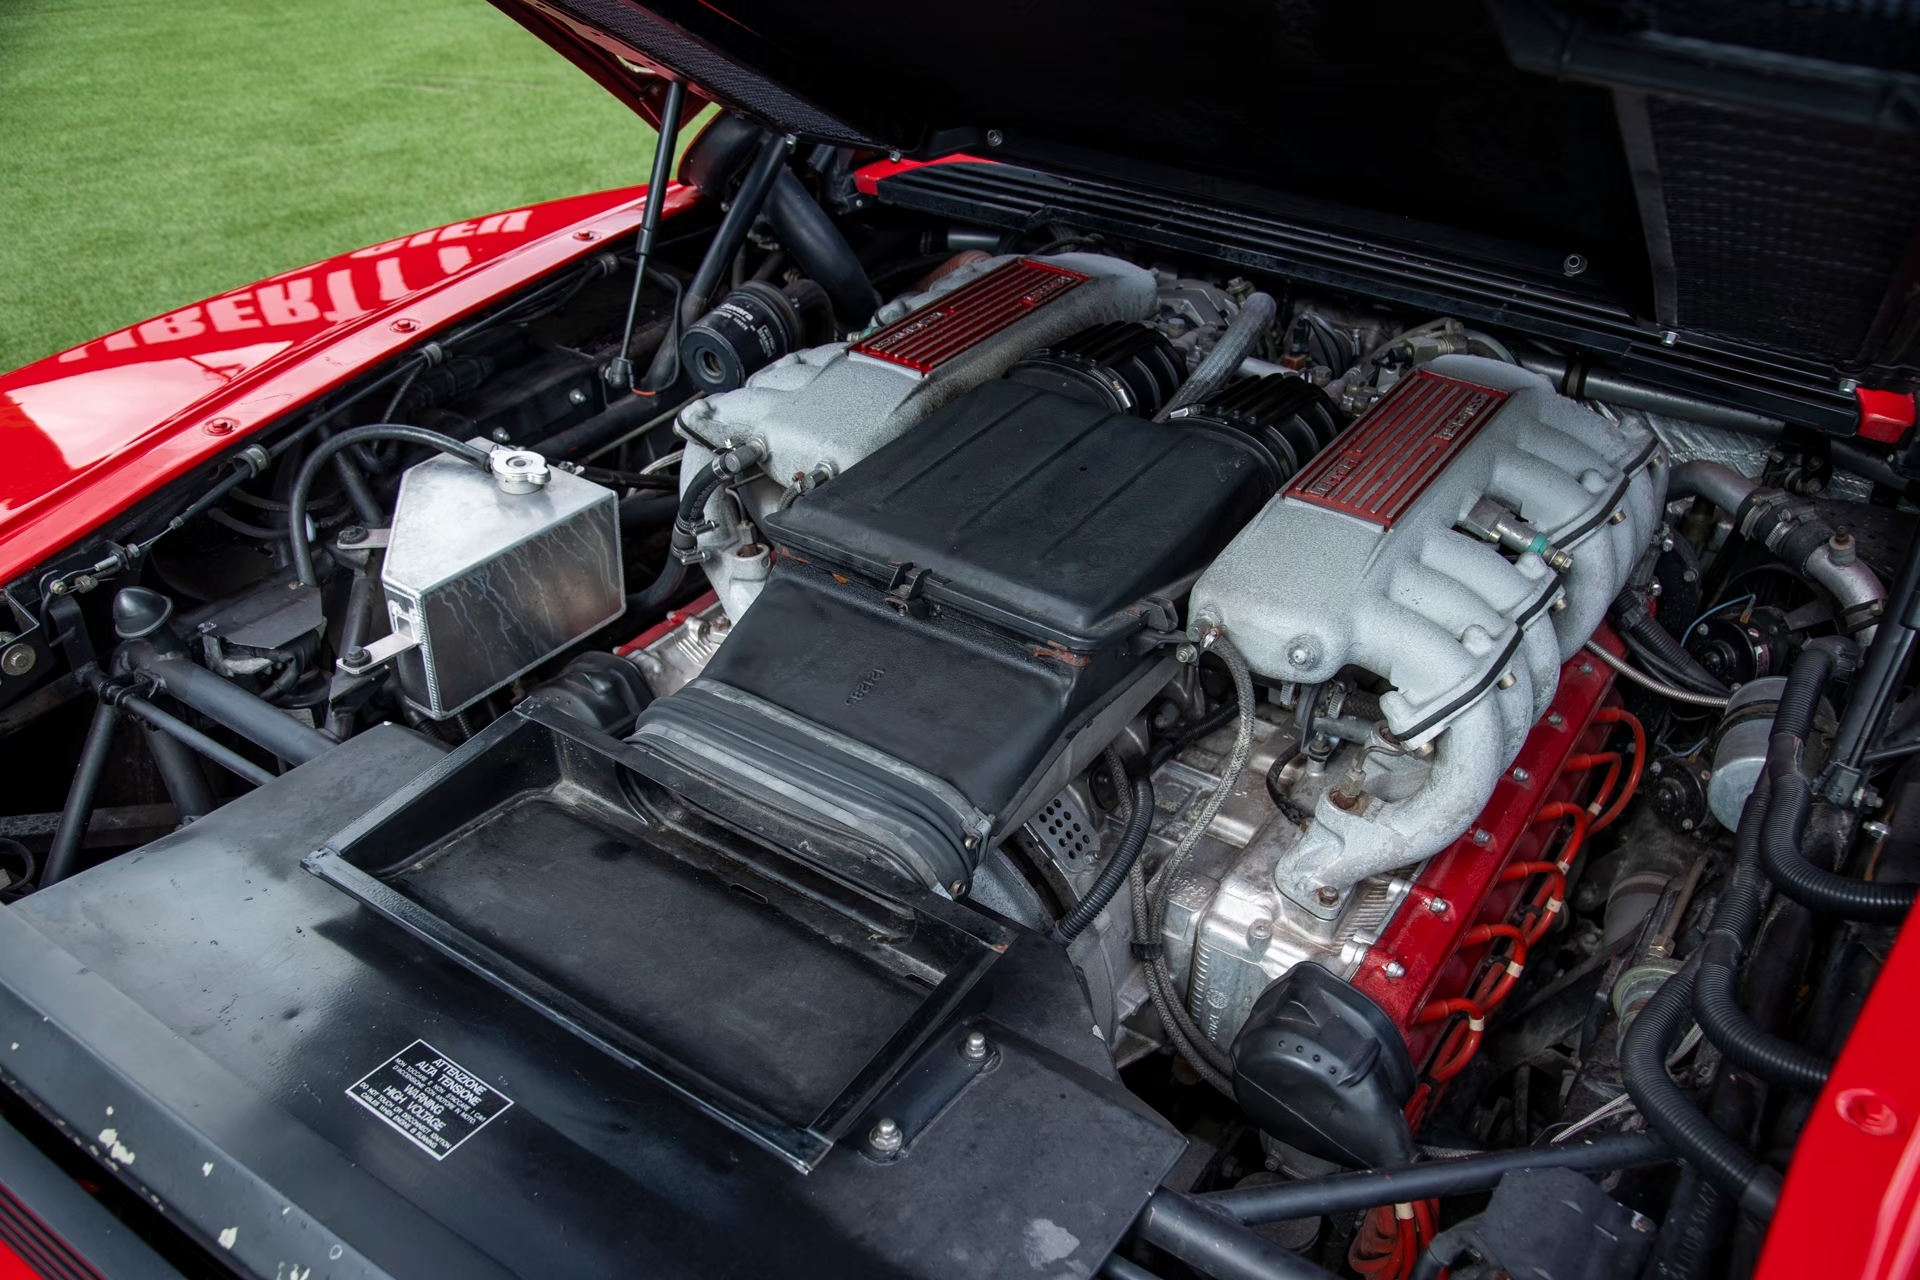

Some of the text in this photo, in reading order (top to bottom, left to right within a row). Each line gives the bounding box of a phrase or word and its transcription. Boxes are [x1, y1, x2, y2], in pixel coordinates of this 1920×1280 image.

[415, 1061, 482, 1106] ALTA TENSIONE
[432, 1059, 487, 1095] ATTENZIONE
[433, 1084, 445, 1094] NON
[361, 1092, 380, 1107] CABLES
[379, 1105, 394, 1117] WHEN
[393, 1115, 412, 1129] ENGINE
[383, 1085, 446, 1131] HIGH VOLTAGE
[404, 1084, 444, 1115] WARNING
[424, 1087, 437, 1096] CON
[435, 1095, 456, 1110] MOTORE
[367, 1088, 380, 1096] NOT
[377, 1094, 395, 1108] TOUCH
[401, 1112, 432, 1134] DISCONNECT
[430, 1132, 452, 1149] IGNITION
